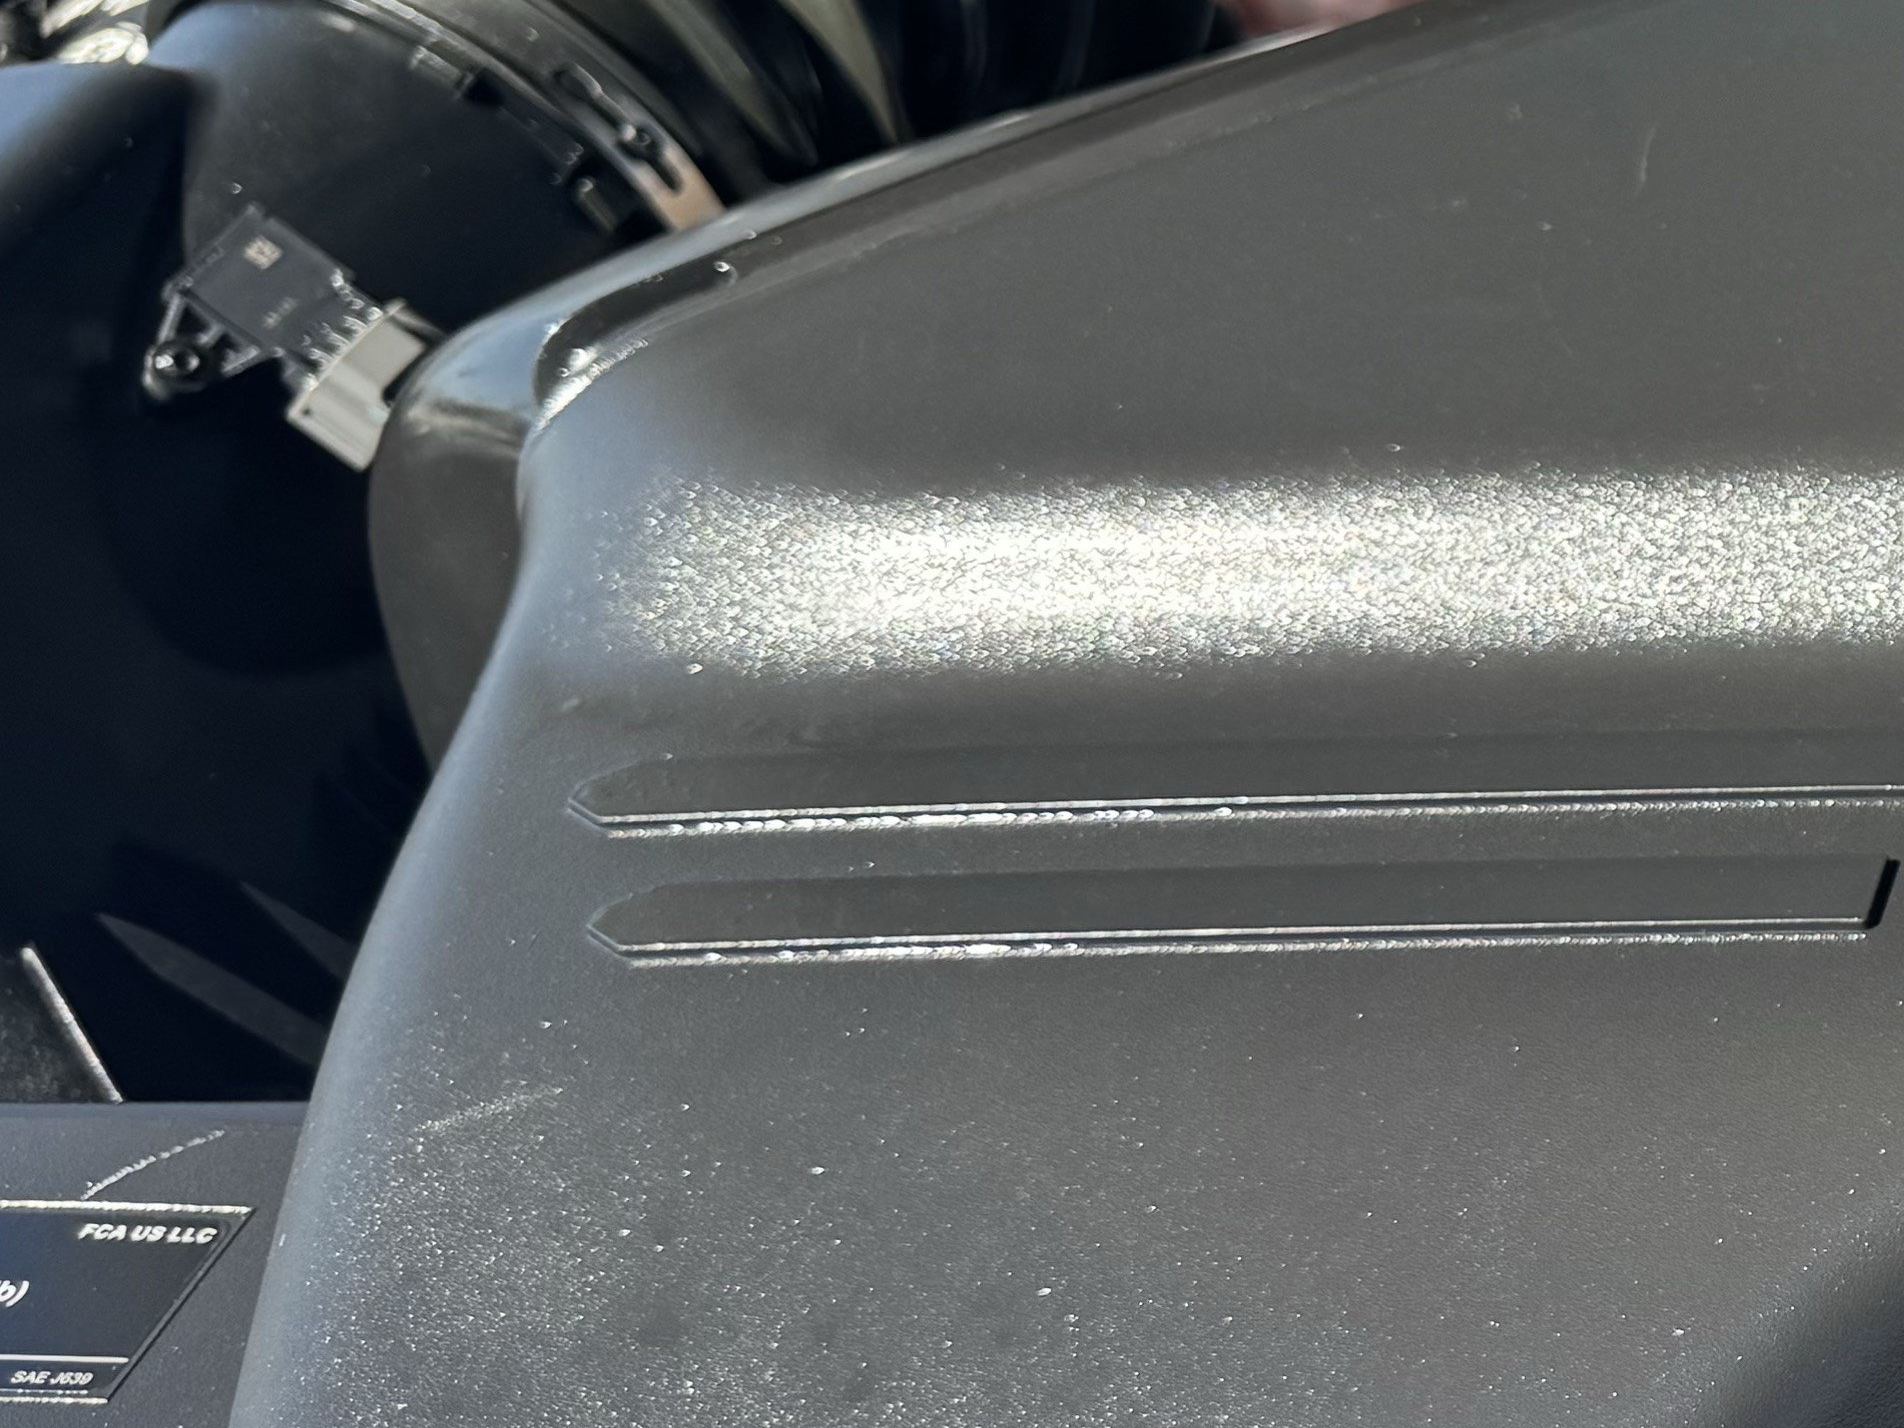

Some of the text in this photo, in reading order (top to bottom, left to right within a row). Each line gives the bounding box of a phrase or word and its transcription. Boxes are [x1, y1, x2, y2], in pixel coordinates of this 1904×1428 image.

[77, 1222, 218, 1244] FCA US LLC
[0, 1279, 30, 1308] b)
[10, 1369, 94, 1386] SAE J639
